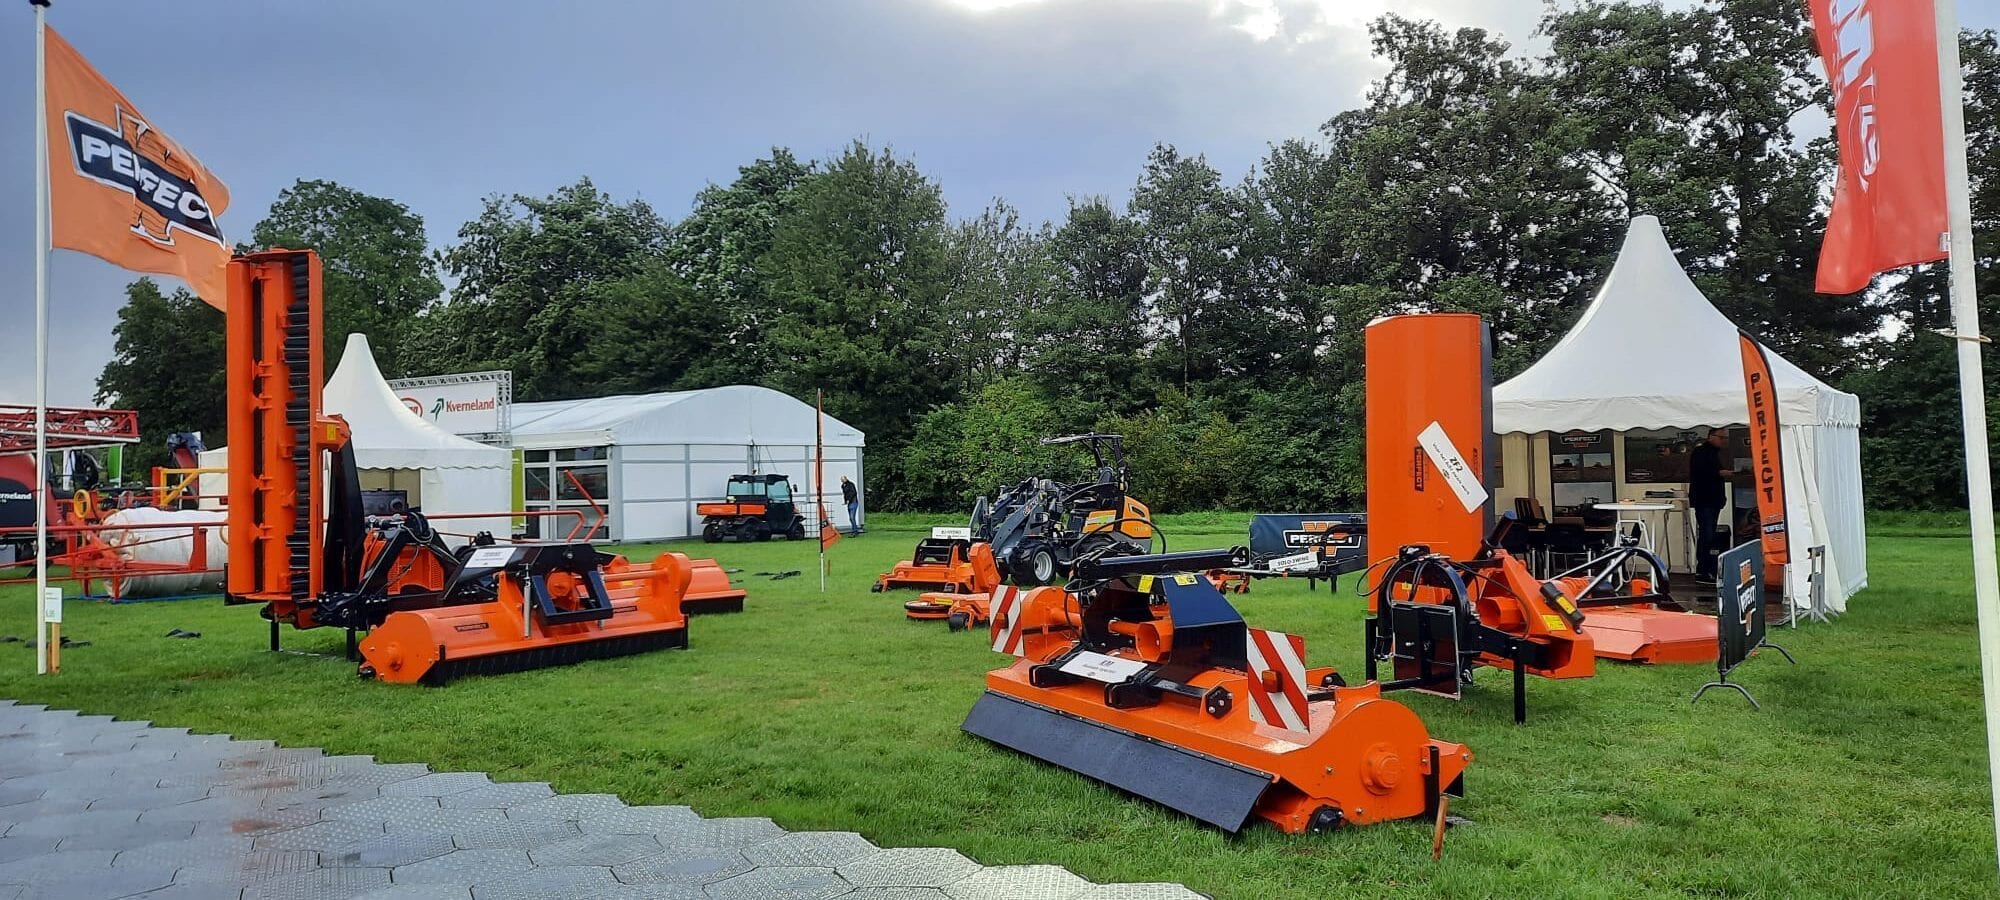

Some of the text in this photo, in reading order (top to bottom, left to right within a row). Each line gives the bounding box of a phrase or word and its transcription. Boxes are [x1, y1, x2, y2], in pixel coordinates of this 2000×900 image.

[446, 398, 495, 412] Kverneland
[1750, 371, 1774, 504] PERFECT
[1449, 456, 1464, 473] ZF2
